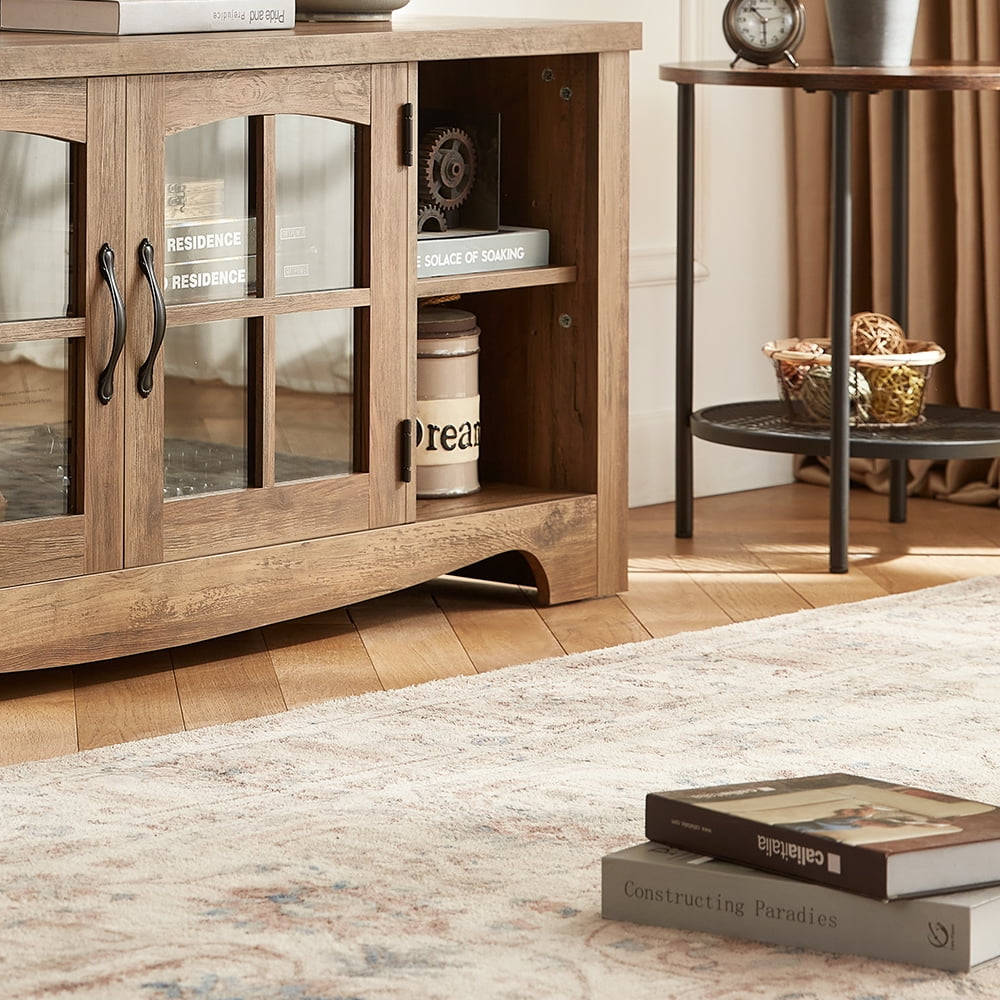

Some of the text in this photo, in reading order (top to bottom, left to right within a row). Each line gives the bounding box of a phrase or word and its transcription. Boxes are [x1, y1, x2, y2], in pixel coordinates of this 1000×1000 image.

[213, 9, 285, 25] Pride and Prejudice
[167, 231, 242, 253] RESIDENCE
[425, 252, 462, 268] SOLACE
[465, 250, 478, 264] OF
[481, 246, 525, 263] SOAKING
[172, 269, 246, 290] RESIDENCE
[756, 834, 825, 867] caliaitalia
[623, 880, 838, 929] Constructing Paradies
